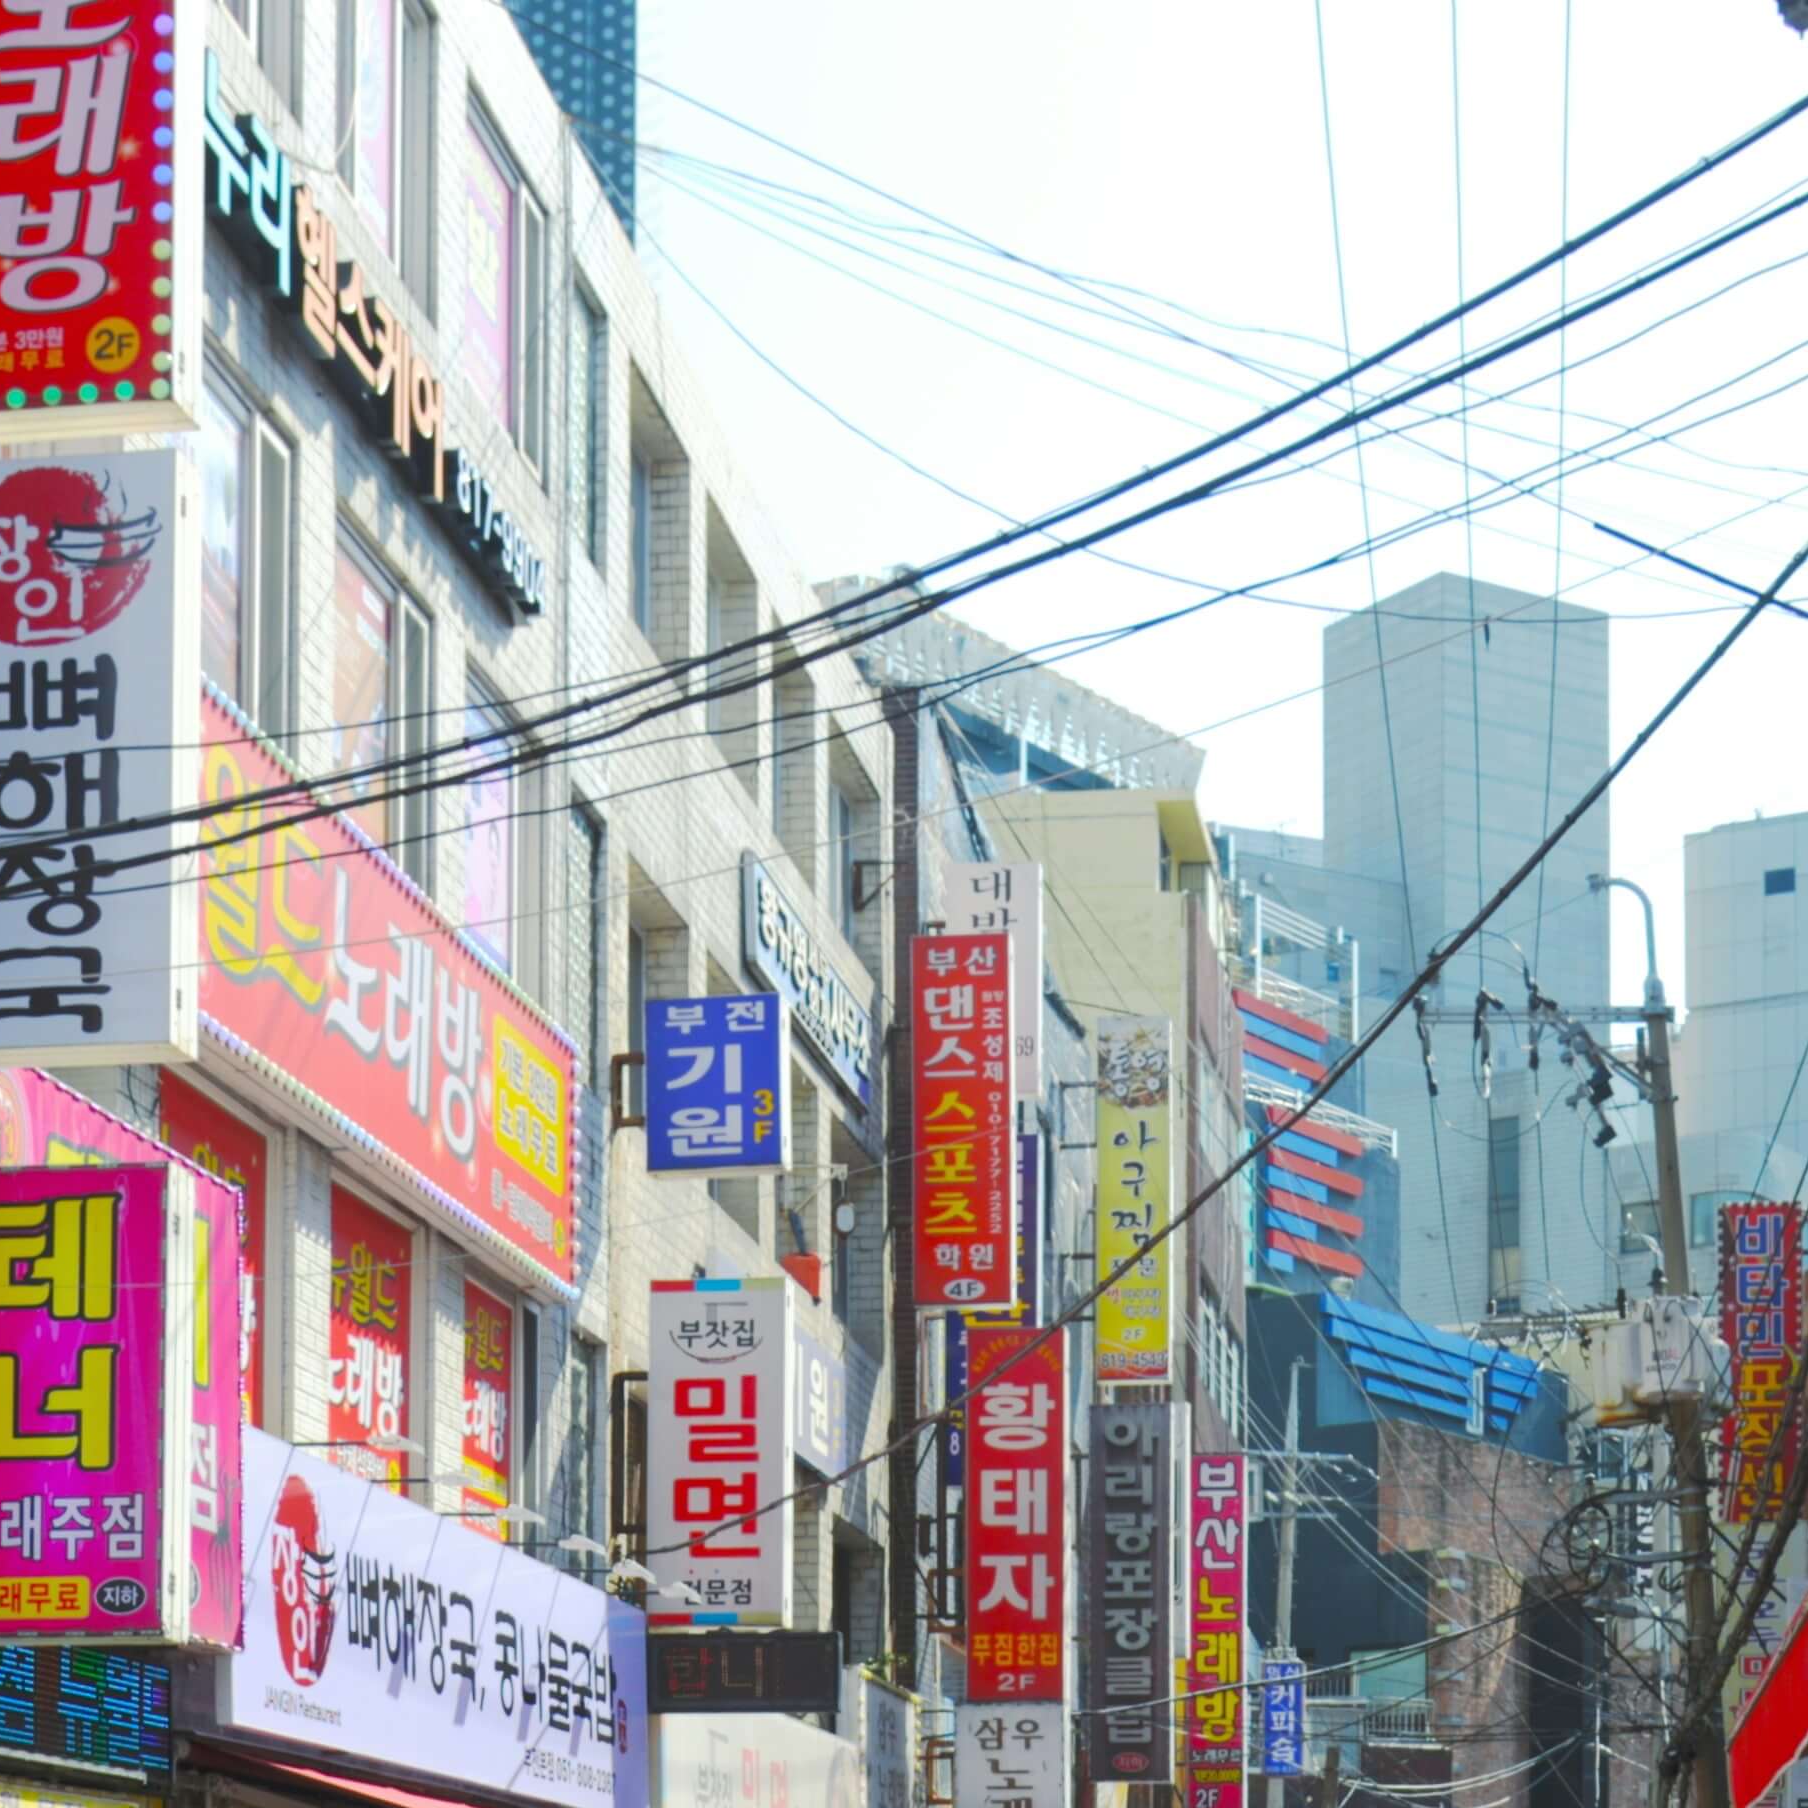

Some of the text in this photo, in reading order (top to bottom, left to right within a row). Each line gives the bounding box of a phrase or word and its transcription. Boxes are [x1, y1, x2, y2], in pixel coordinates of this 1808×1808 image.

[93, 330, 135, 360] 2F
[294, 183, 445, 502] 헬스케어
[926, 944, 996, 977] 부산
[664, 1002, 766, 1034] 부전
[981, 1007, 1004, 1083] 조성제
[665, 1042, 744, 1158] 기원
[753, 1088, 775, 1144] 3F
[923, 983, 978, 1235] 댄스 스포츠
[934, 1243, 994, 1271] 학원
[948, 1280, 982, 1298] 4F
[1736, 1213, 1789, 1360] 비타민
[676, 1317, 757, 1349] 부잣집
[673, 1373, 761, 1559] 밀면
[977, 1383, 1056, 1622] 황태자
[102, 1584, 138, 1606] 지하
[272, 1525, 334, 1683] 장인
[971, 1632, 1059, 1667] 푸짐한집
[997, 1673, 1035, 1691] 2F
[974, 1717, 1045, 1751] 삼우
[1195, 1787, 1219, 1808] 2F
